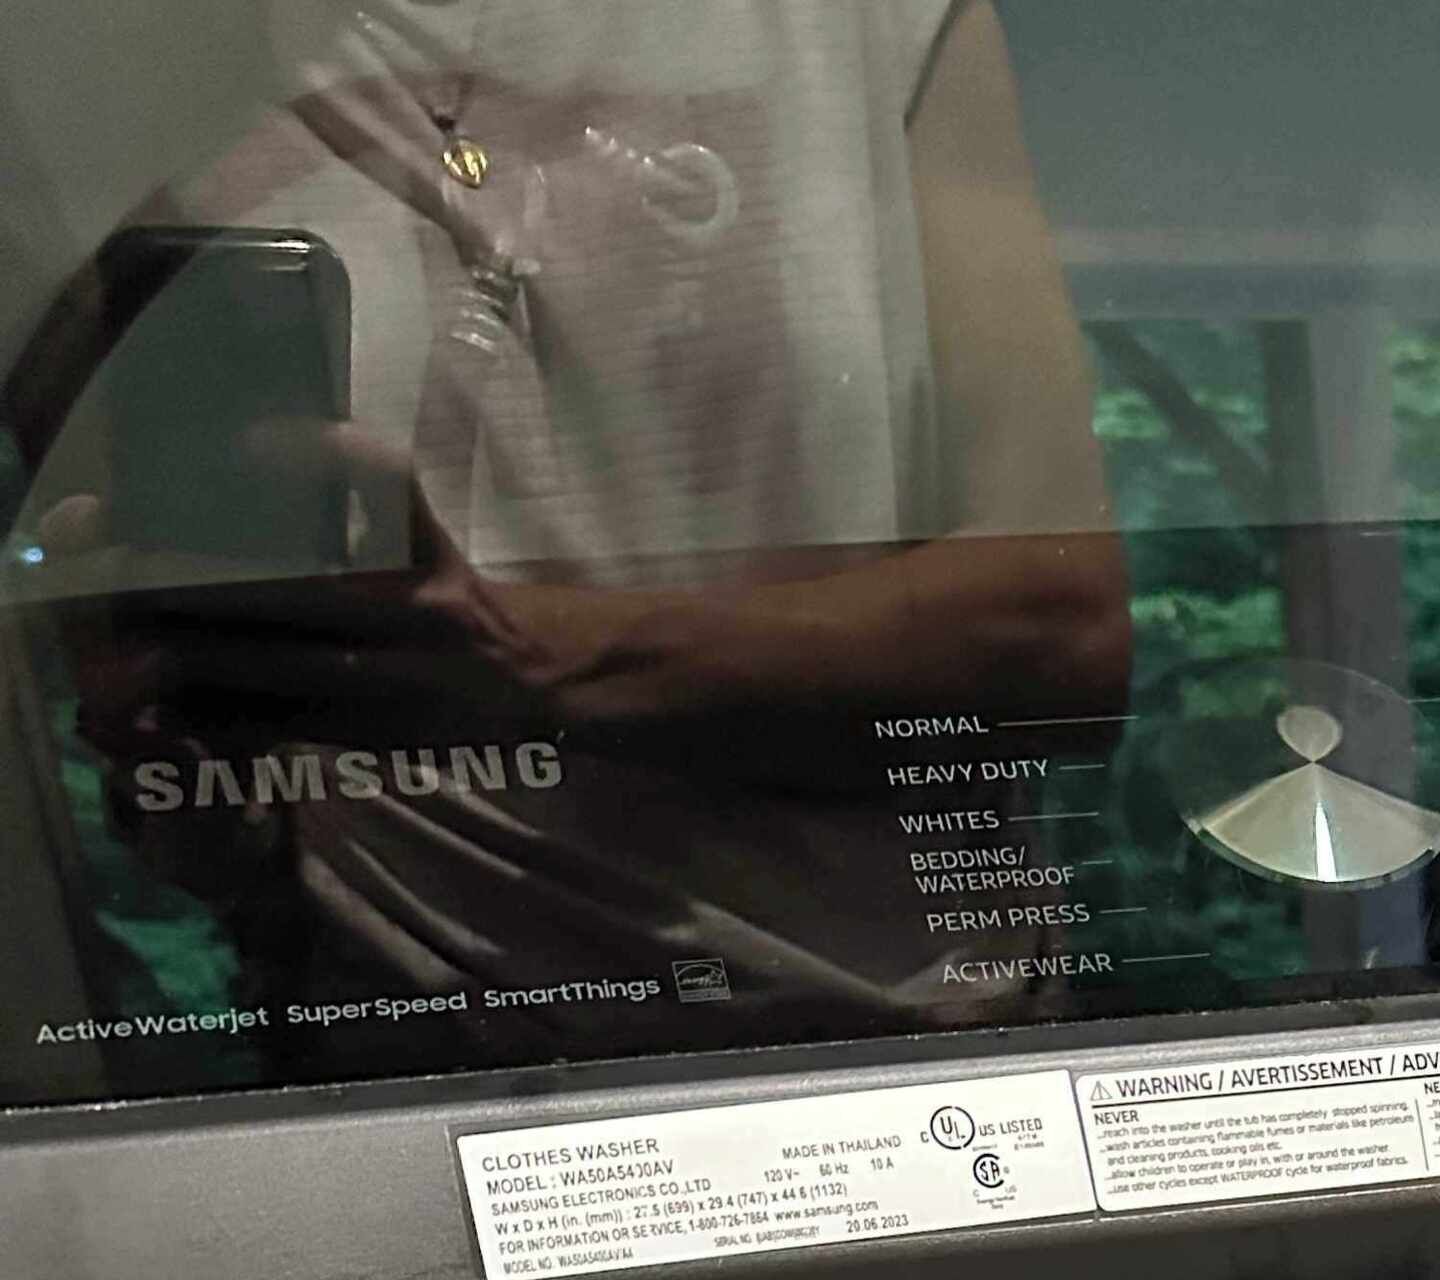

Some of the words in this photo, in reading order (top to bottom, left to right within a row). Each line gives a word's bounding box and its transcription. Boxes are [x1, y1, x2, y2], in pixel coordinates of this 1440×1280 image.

[874, 715, 989, 739] NORMAL
[134, 741, 563, 812] SAMSUNG
[887, 763, 972, 787] HEAVY
[981, 758, 1048, 780] DUTY
[899, 810, 1000, 834] WHITES
[910, 846, 1025, 871] BEDDING/
[915, 866, 1075, 894] WATERPROOF
[927, 908, 1001, 933] PERM
[1008, 903, 1090, 927] PRESS
[943, 952, 1114, 983] ACTIVEWEAR
[484, 976, 661, 1013] SmartThings
[1116, 1072, 1213, 1098] WARNING
[1218, 1070, 1225, 1092] /
[1232, 1057, 1383, 1088] AVERTISSEMENT
[1389, 1054, 1396, 1076] /
[1424, 1081, 1440, 1094] NE
[979, 1123, 996, 1136] US
[1000, 1118, 1043, 1134] LISTED
[1094, 1110, 1139, 1125] NEVER
[482, 1147, 571, 1173] CLOTHES
[576, 1138, 660, 1162] WASHER
[782, 1144, 820, 1160] MADE
[822, 1143, 836, 1156] IN
[839, 1135, 902, 1154] THAILAND
[763, 1169, 784, 1183] 120
[819, 1164, 833, 1177] 60
[835, 1162, 849, 1174] Hz
[870, 1158, 883, 1171] 10
[885, 1156, 895, 1169] A
[1220, 1166, 1283, 1183] WATERPROOF
[486, 1174, 547, 1196] MODEL
[490, 1194, 559, 1217] SAMSUNG
[562, 1184, 656, 1208] ELECTRONICS
[495, 1221, 509, 1236] W
[512, 1223, 520, 1234] x
[523, 1219, 534, 1232] D
[538, 1220, 545, 1231] x
[548, 1216, 559, 1230] H
[697, 1200, 705, 1211] x
[737, 1190, 768, 1208] (747)
[771, 1192, 778, 1203] x
[810, 1181, 848, 1200] (1132)
[846, 1213, 910, 1234] 20.06.2023
[498, 1239, 525, 1255] FOR
[528, 1229, 609, 1252] INFORMATION
[612, 1227, 630, 1241] OR
